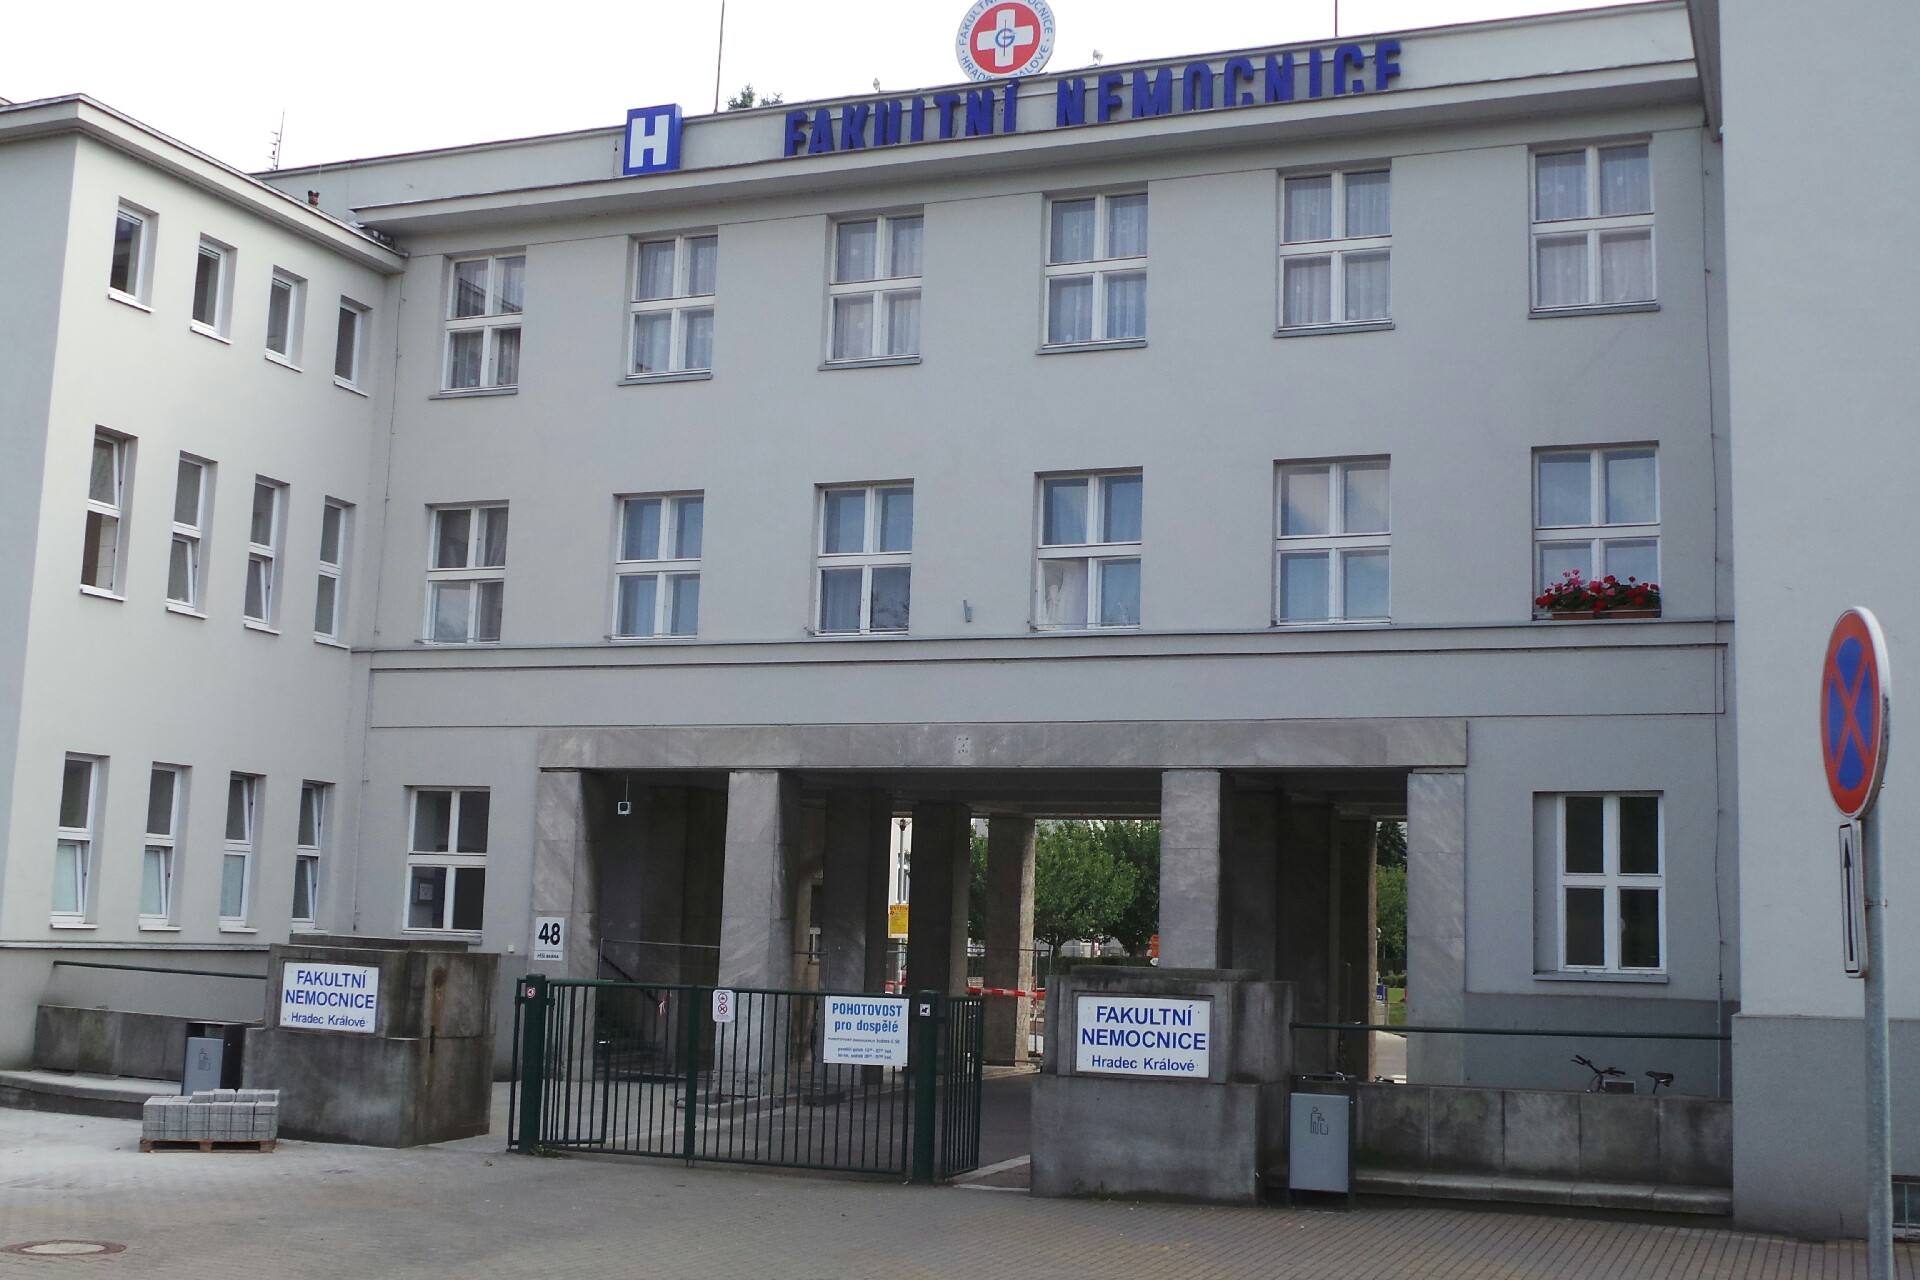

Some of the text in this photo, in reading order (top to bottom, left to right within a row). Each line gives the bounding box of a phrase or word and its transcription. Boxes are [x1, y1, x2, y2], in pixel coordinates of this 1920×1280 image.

[1056, 39, 1402, 128] NEMOCNICE
[629, 114, 670, 169] H
[538, 922, 561, 946] 48
[296, 969, 368, 989] FAKULTNÍ
[284, 989, 375, 1010] NEMOCNICE
[832, 1002, 903, 1017] POHOTOVOST
[291, 1012, 366, 1028] Hradec Králové
[1096, 1004, 1194, 1027] FAKULTNÍ
[834, 1019, 899, 1034] pro dospělé
[1081, 1027, 1207, 1051] NEMOCNICE
[1091, 1054, 1195, 1072] Hradec Králové
